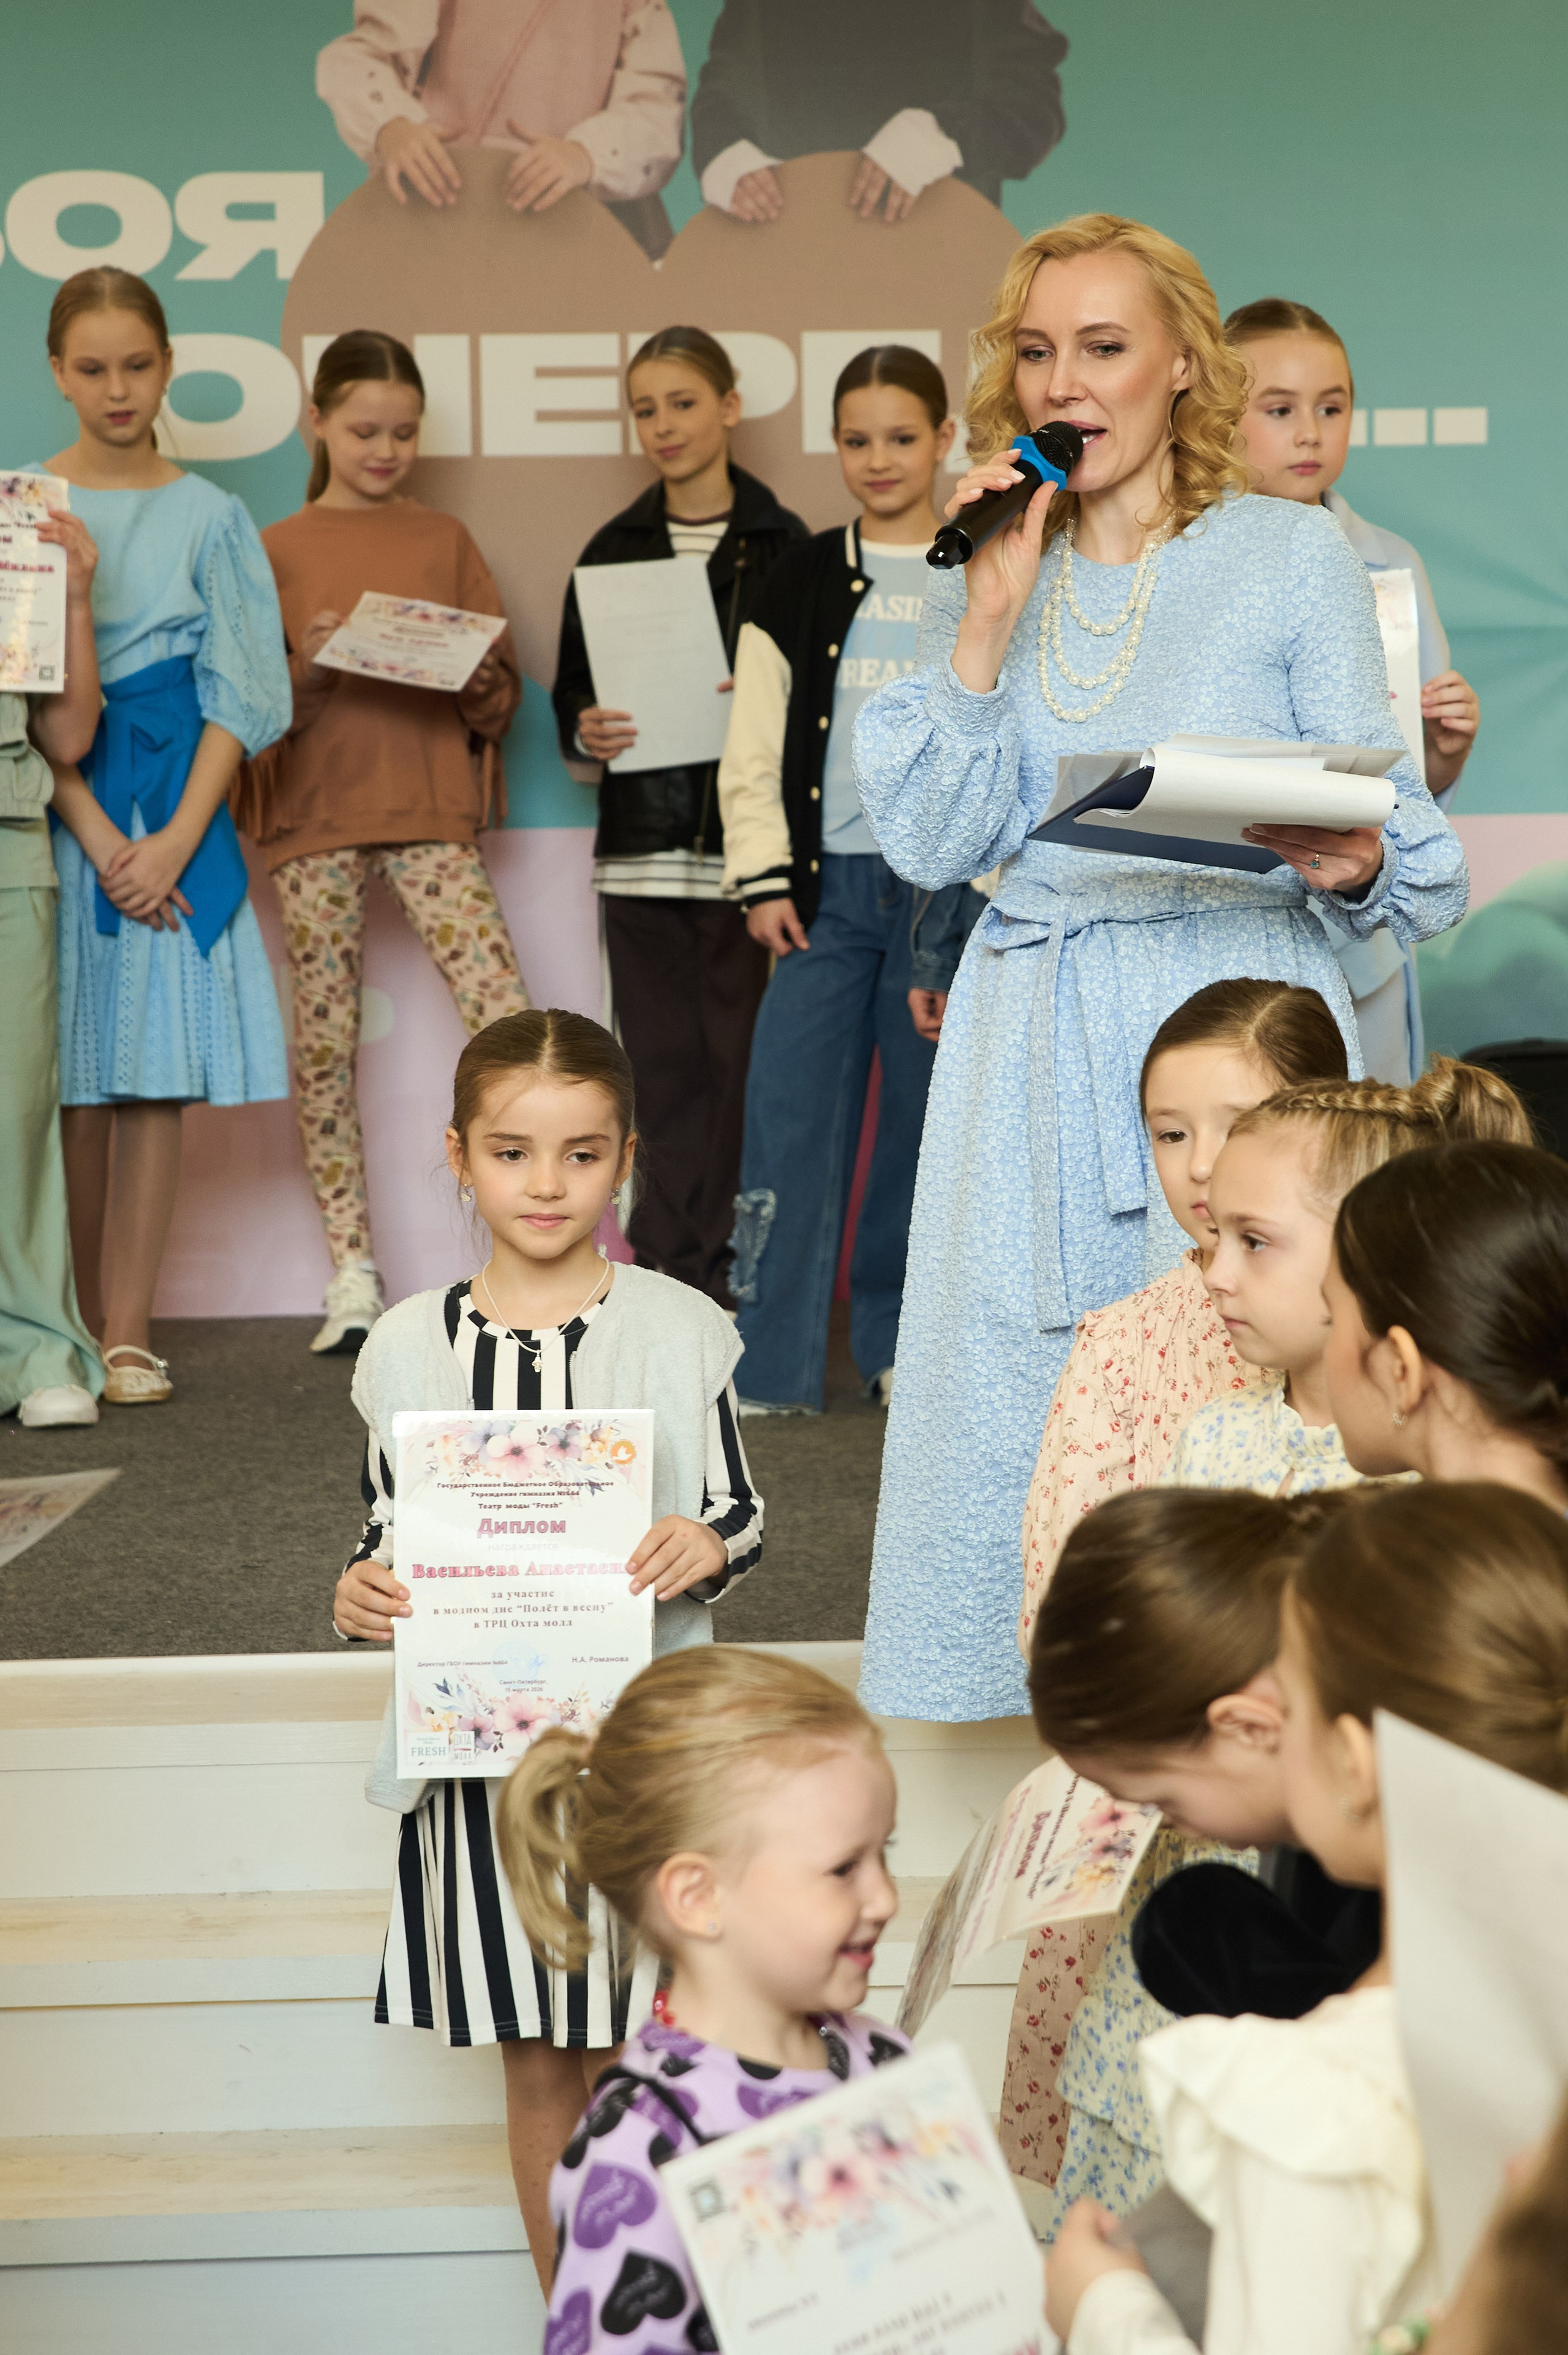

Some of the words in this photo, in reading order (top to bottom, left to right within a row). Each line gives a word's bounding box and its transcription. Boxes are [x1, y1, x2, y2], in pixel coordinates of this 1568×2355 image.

[0, 169, 325, 281] ОЯ
[437, 1481, 502, 1490] Государственное
[477, 1518, 566, 1538] Диплом
[412, 1563, 519, 1579] Васильева
[524, 1561, 628, 1576] Анастаси
[507, 1590, 554, 1600] участие
[483, 1620, 507, 1629] ТРЦ
[511, 1619, 539, 1628] Охта
[411, 1747, 446, 1756] FRESH
